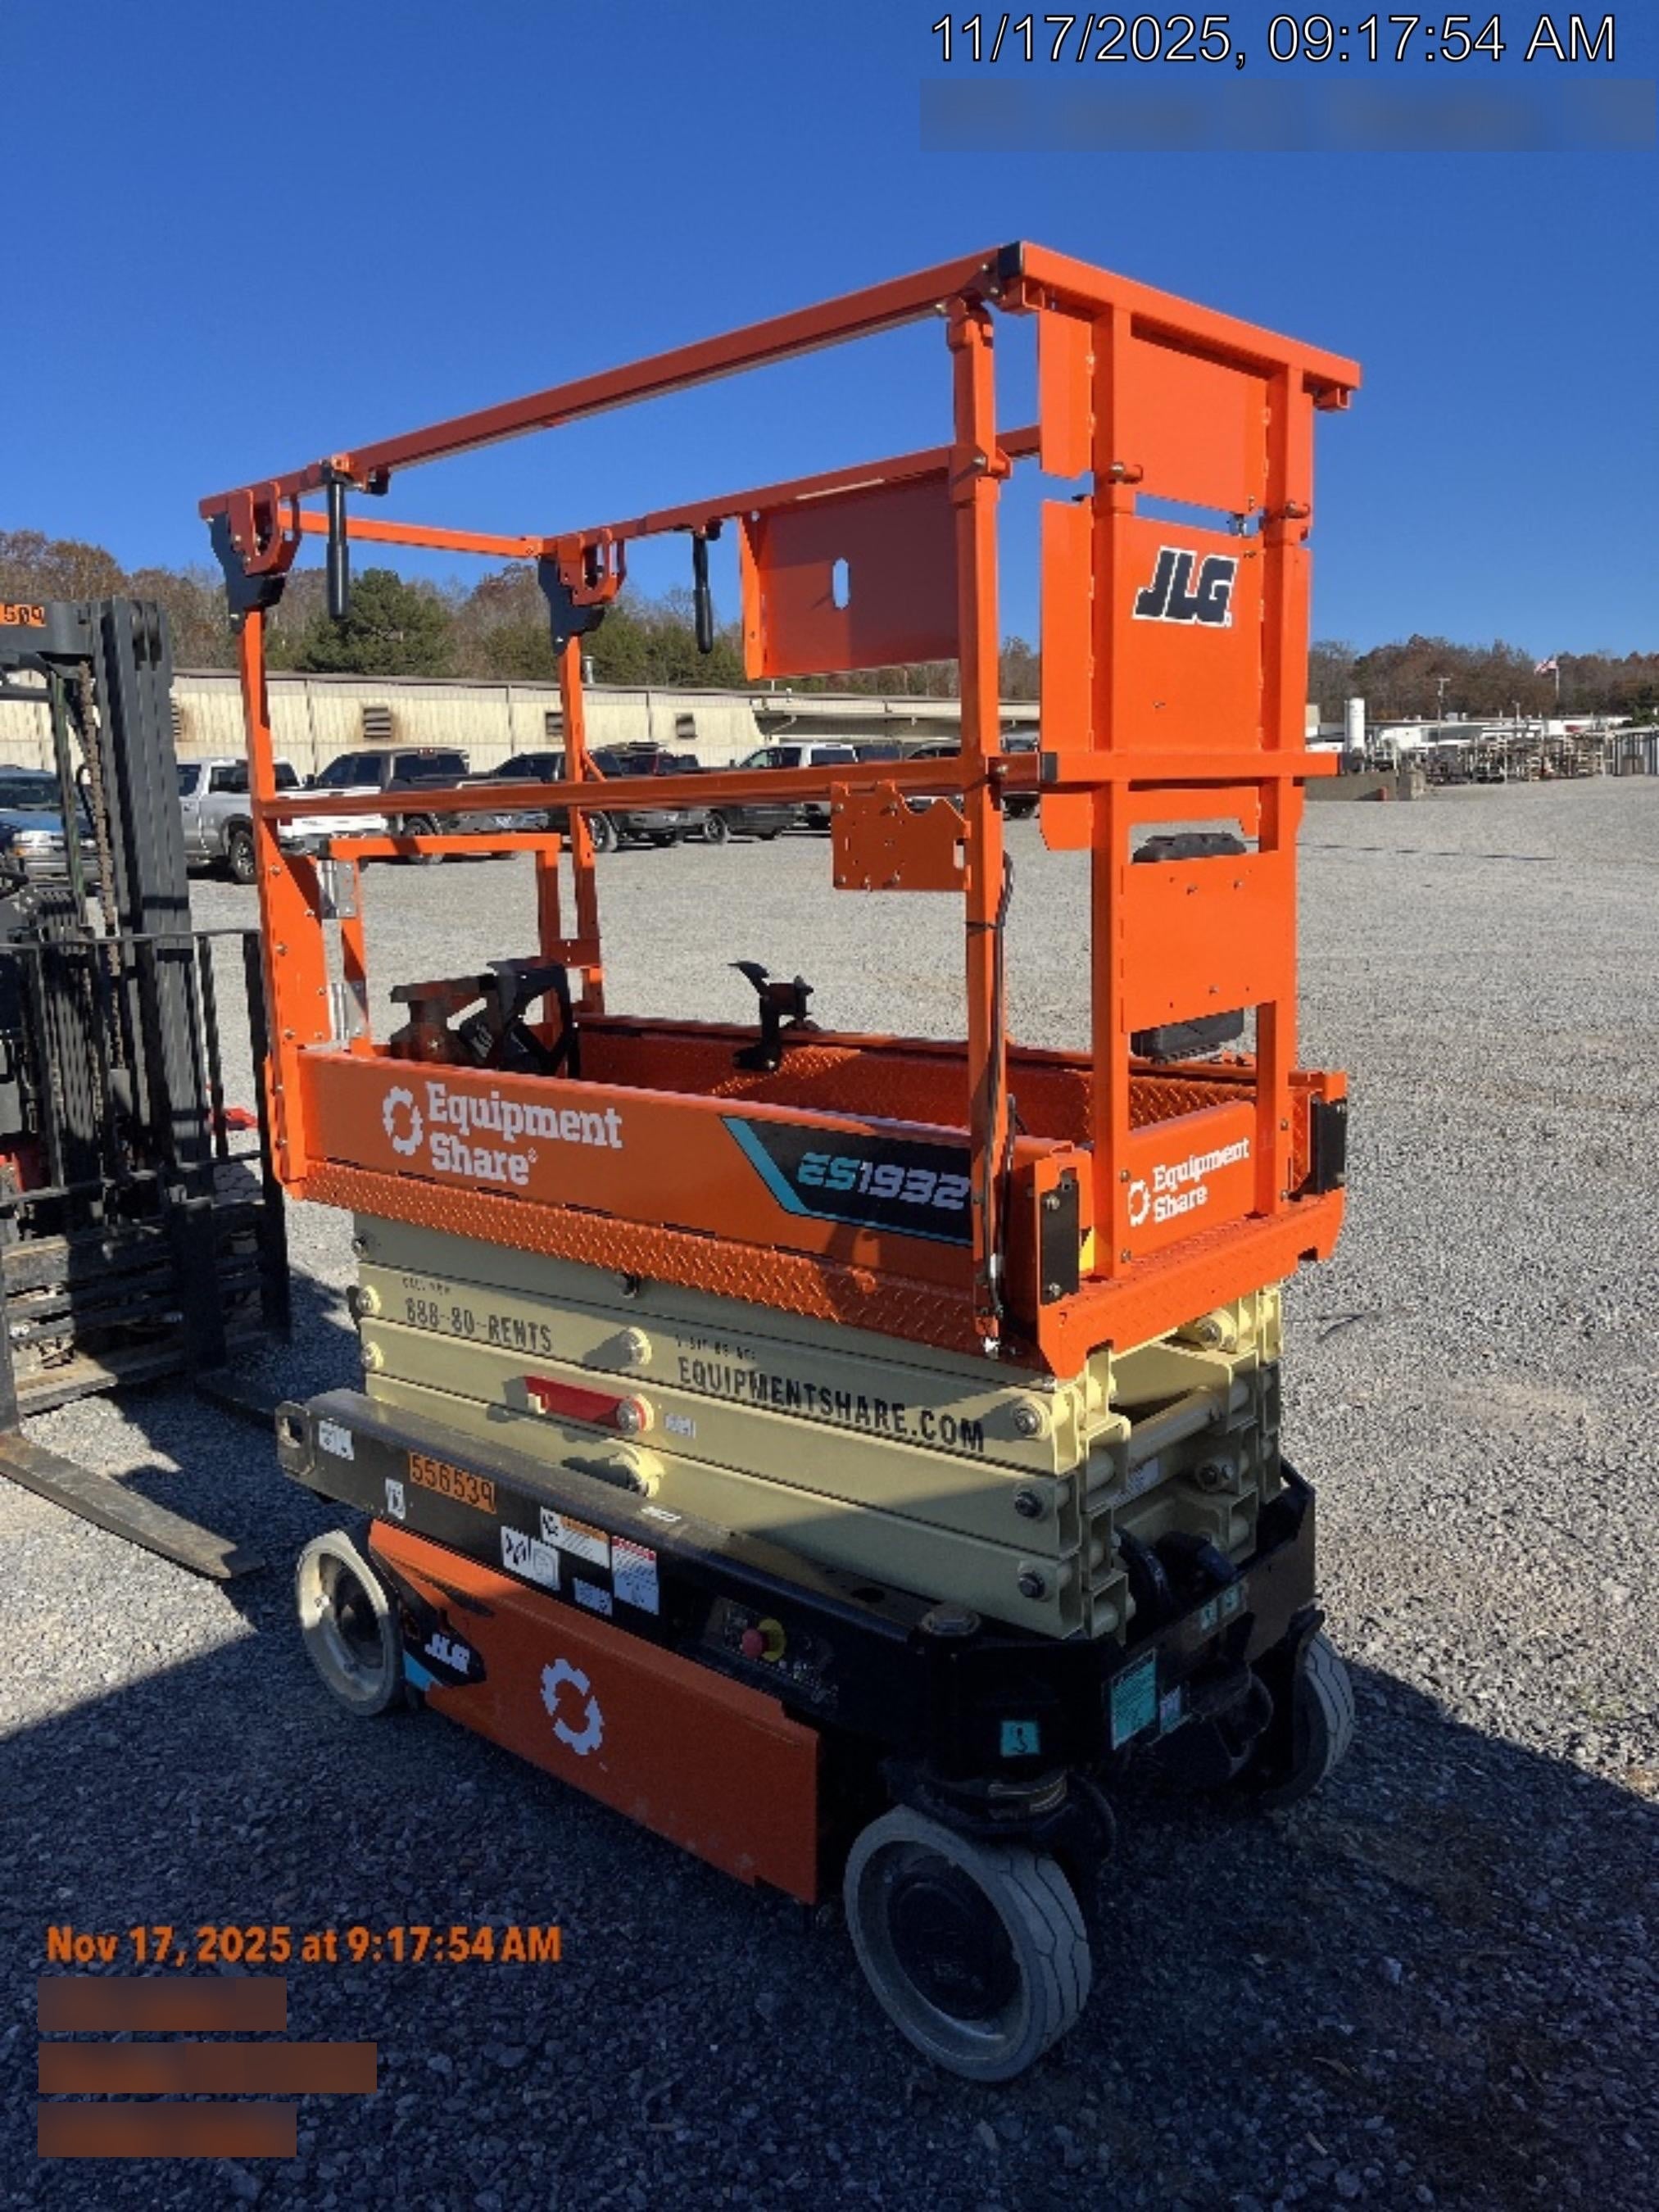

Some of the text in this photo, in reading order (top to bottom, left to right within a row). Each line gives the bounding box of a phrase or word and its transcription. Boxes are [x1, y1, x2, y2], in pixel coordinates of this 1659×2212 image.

[1131, 545, 1240, 628] JLG
[424, 1081, 623, 1149] Equipment
[796, 1150, 972, 1211] ES1932
[1152, 1136, 1251, 1194] Equipment
[1154, 1184, 1208, 1224] Share
[678, 1356, 984, 1452] EQUIPMENTSHARE.COM
[410, 1454, 495, 1509] 556539
[424, 1634, 470, 1675] JLG
